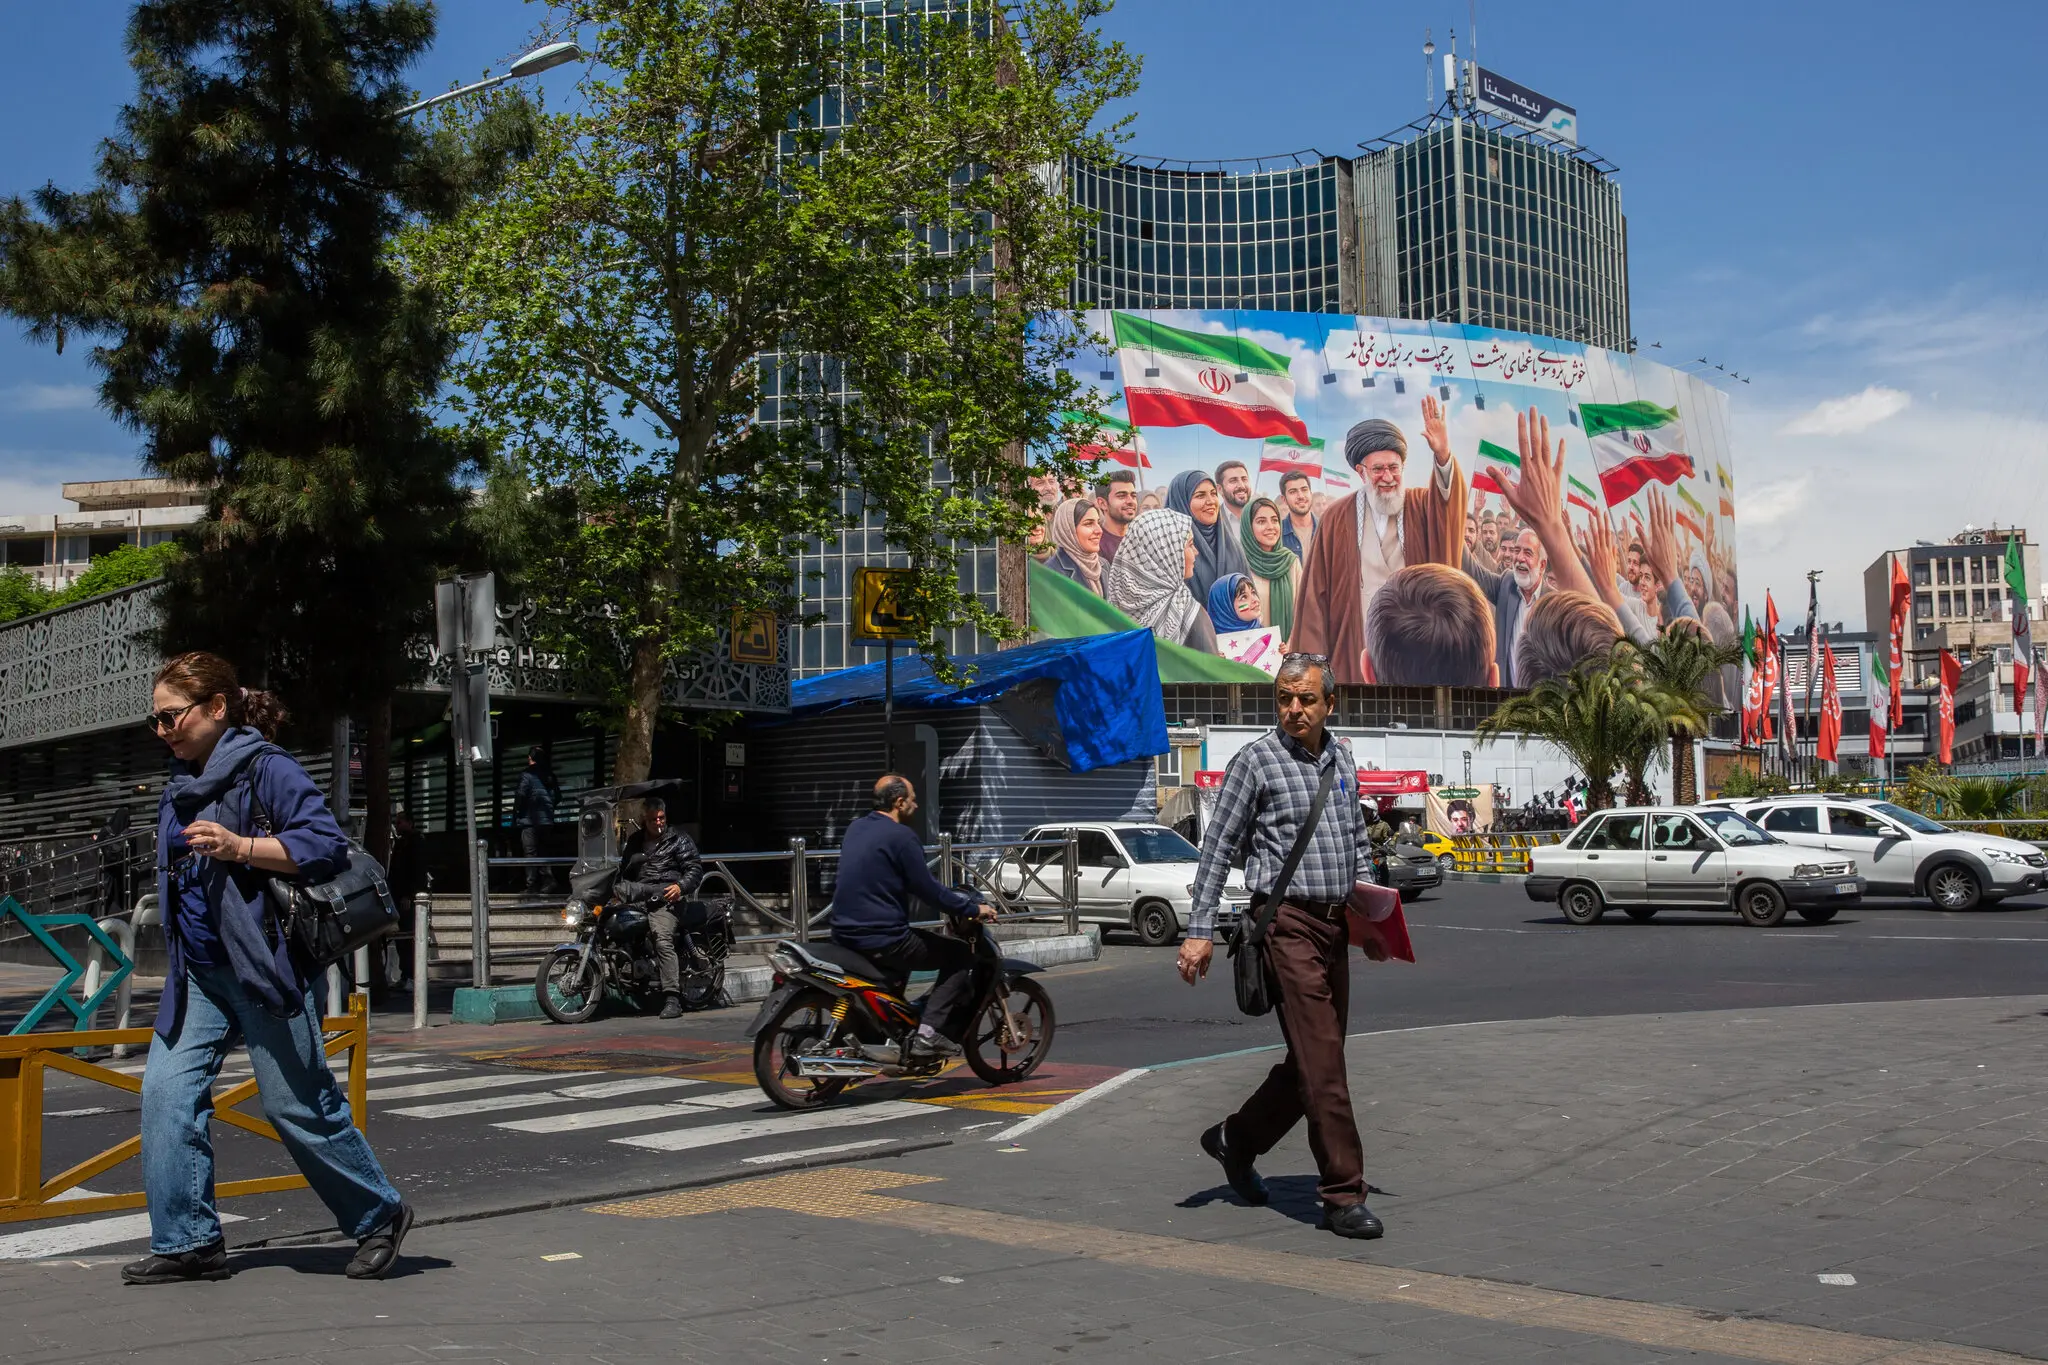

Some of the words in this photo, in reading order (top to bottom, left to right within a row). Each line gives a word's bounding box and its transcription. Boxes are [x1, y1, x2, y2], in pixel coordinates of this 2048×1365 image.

[1483, 77, 1512, 101] سینا
[1511, 92, 1541, 117] بیمه
[1375, 342, 1402, 368] زمین
[1402, 350, 1413, 368] بر
[1414, 345, 1454, 374] پرچمت
[1470, 344, 1507, 370] بهشت
[1563, 360, 1586, 389] خوش
